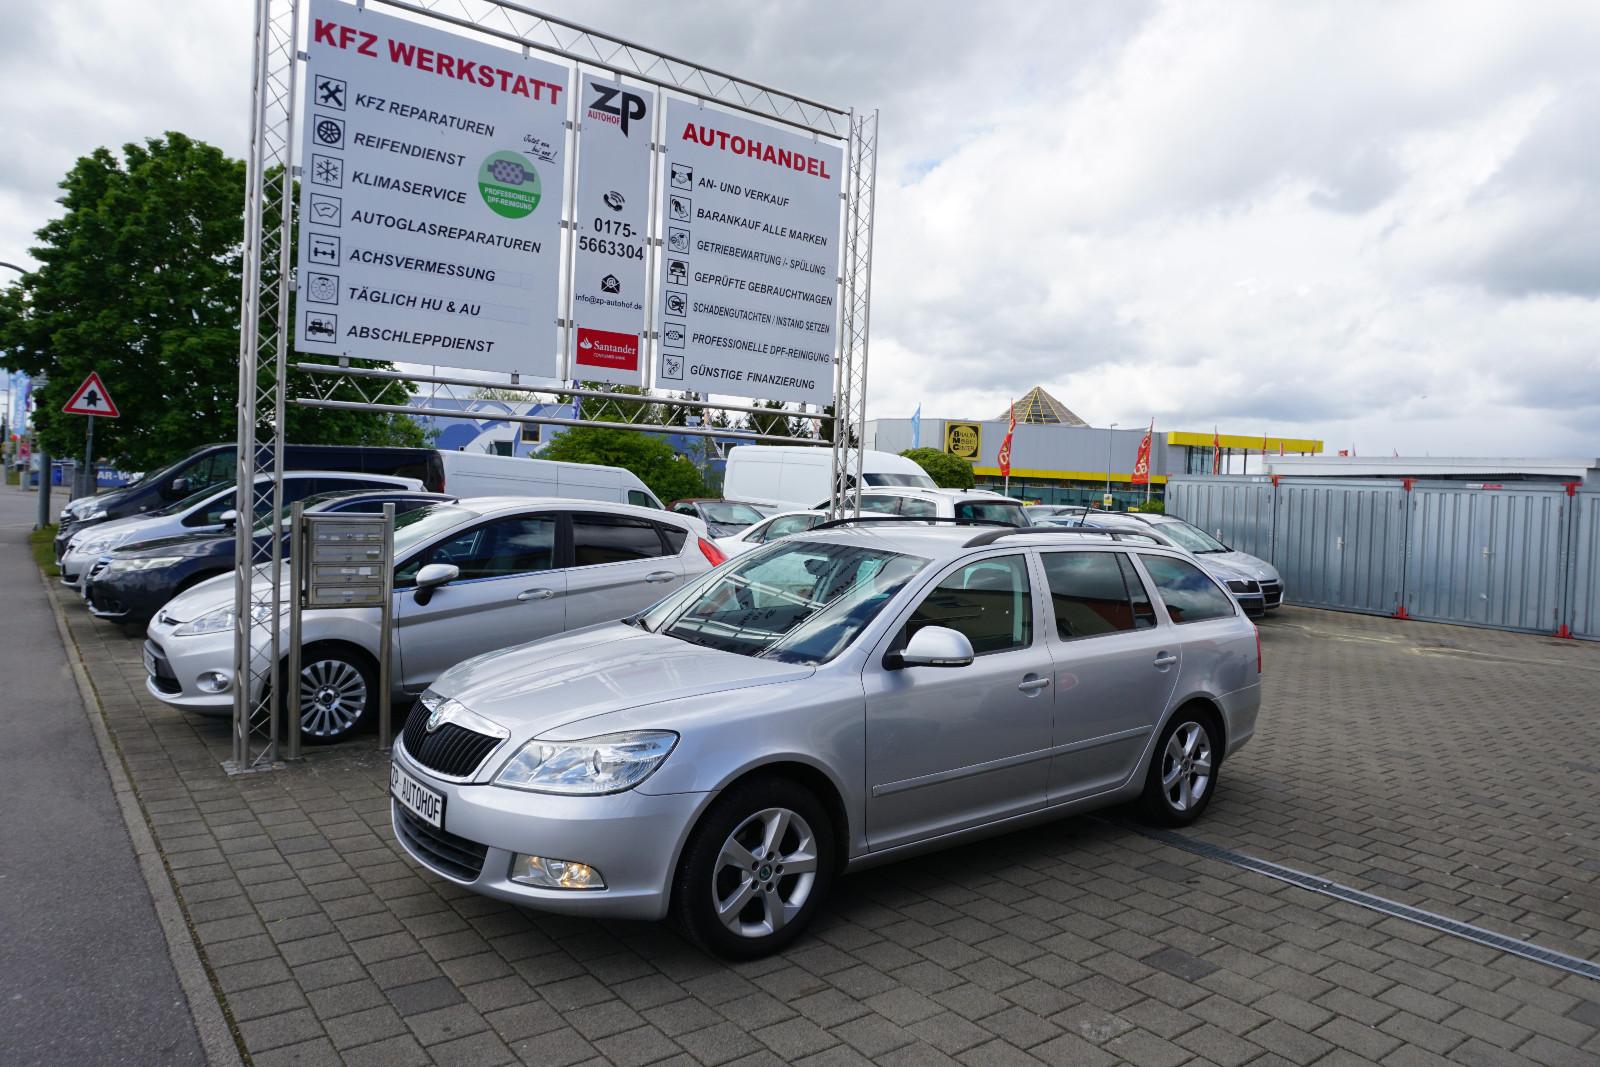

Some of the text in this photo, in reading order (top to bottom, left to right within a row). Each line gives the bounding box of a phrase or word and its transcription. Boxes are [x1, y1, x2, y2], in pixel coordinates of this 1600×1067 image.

[314, 19, 563, 105] KFZ WERKSTATT
[355, 93, 495, 137] KFZ REPARATUREN
[587, 109, 620, 126] AUTOHOF
[354, 132, 466, 167] REIFENDIENST
[682, 122, 831, 180] AUTOHANDEL
[352, 171, 467, 204] KLIMASERVICE
[484, 186, 536, 203] PROFESSIONELLE
[698, 177, 790, 207] AN- UND VERKAUF
[351, 209, 542, 253] AUTOGLASREPARATUREN
[594, 217, 636, 237] 0175-
[697, 208, 828, 246] BARANKAUF ALLE MARKEN
[579, 235, 644, 261] 5663304
[697, 241, 781, 266] GETRIEBEWARTUNG
[789, 258, 826, 275] SPÜLUNG
[349, 249, 496, 282] ACHSVERMESSUNG
[349, 286, 481, 316] TÄGLICH HU & AU
[575, 293, 642, 310] info@zp-autohof.de
[694, 271, 833, 306] GEPRÜFTE GEBRAUCHTWAGEN
[692, 302, 771, 324] SCHADENGUTACHTEN
[776, 316, 804, 330] INSTAND
[805, 321, 830, 333] SETZEN
[347, 325, 495, 353] ABSCHLEPPDIENST
[593, 341, 636, 355] Santander
[692, 333, 830, 363] PROFESSIONELLE DPF-REINIGUNG
[690, 364, 815, 390] GÜNSTIGE FINANZIERUNG
[402, 776, 440, 821] AUTOHOF
